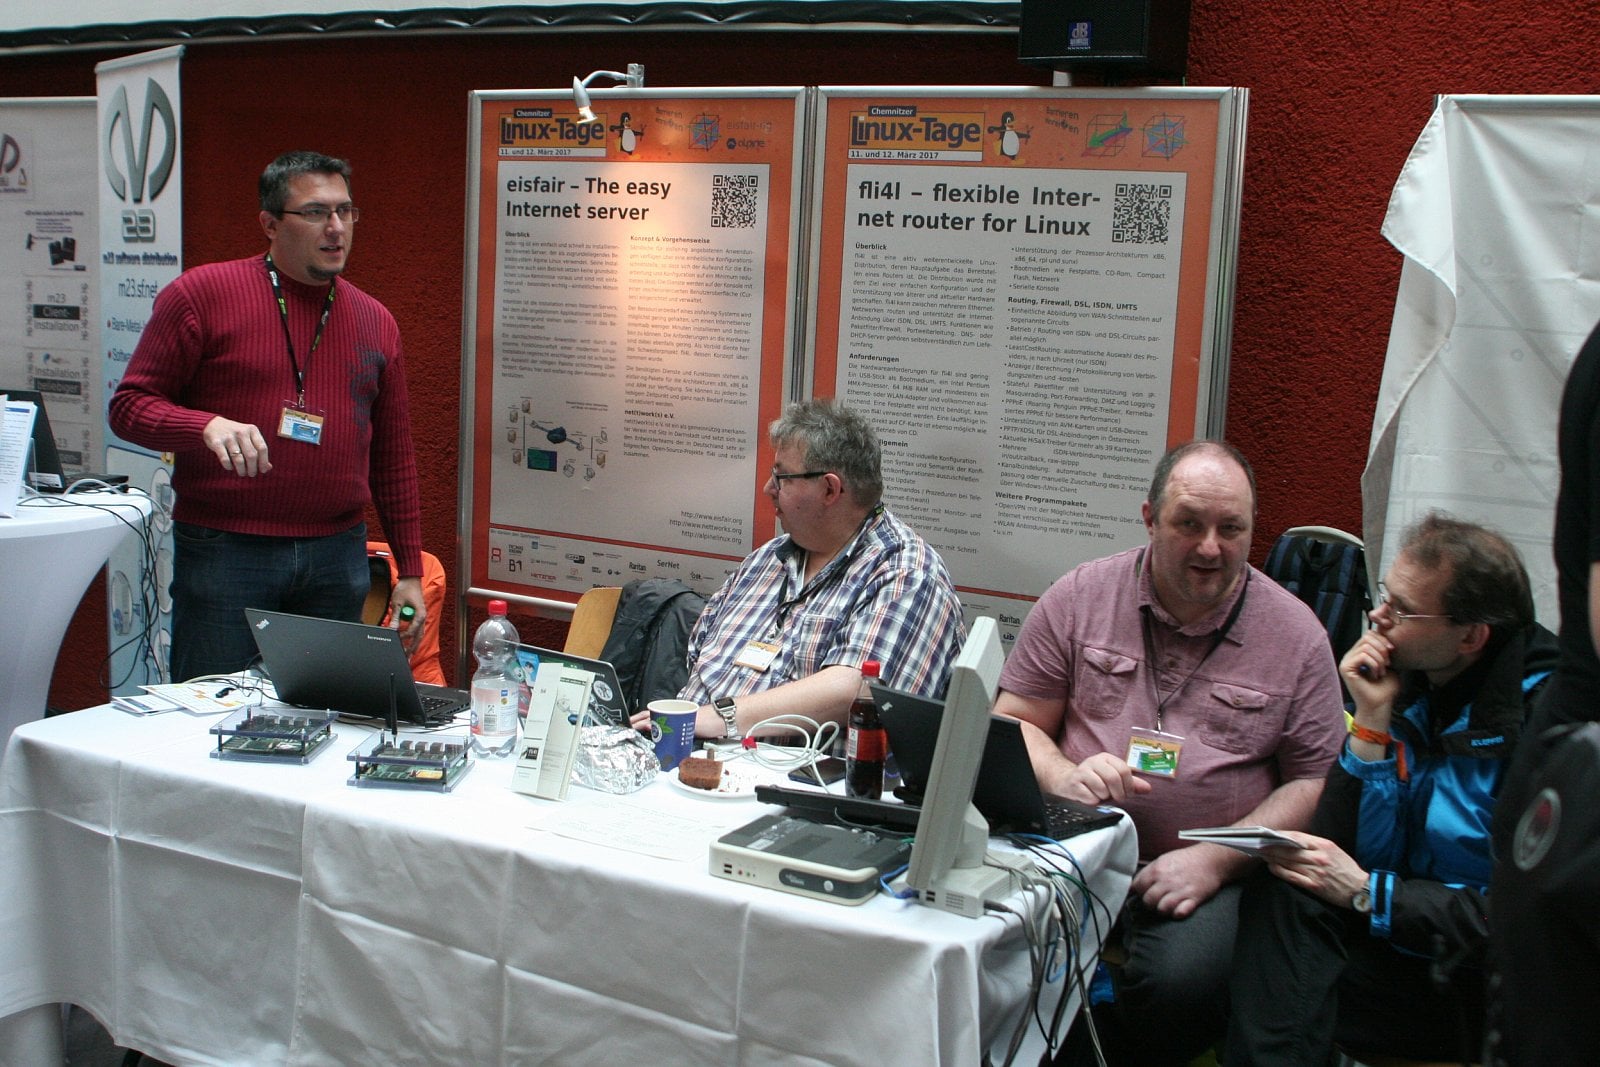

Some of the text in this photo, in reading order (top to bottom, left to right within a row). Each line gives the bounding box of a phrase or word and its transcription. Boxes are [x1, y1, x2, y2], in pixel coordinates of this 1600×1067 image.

[501, 118, 604, 145] Linux-Tage
[852, 116, 980, 148] Linux-Tage
[507, 176, 565, 193] eisfair
[585, 178, 619, 194] The
[626, 182, 671, 199] easy
[859, 181, 900, 200] fli4l
[933, 183, 1020, 204] flexible
[1032, 187, 1100, 207] Inter-
[506, 201, 649, 220] Internet server
[858, 210, 1091, 236] net router for Linux
[855, 241, 887, 249] Überblick
[1015, 246, 1057, 255] Unterstützung
[1008, 296, 1037, 305] Routing,
[1040, 298, 1071, 307] Firewall,
[1074, 300, 1090, 308] DSL,
[1093, 302, 1113, 310] ISDN,
[1047, 309, 1077, 318] Abbildung
[34, 320, 79, 332] Installation
[849, 353, 899, 363] Anforderungen
[34, 367, 80, 378] Installation
[1035, 364, 1070, 373] Berechnung
[1076, 368, 1121, 378] Protokollierung
[995, 491, 1087, 507] Weitere Programmpakete
[1016, 522, 1046, 532] Anbindung
[509, 559, 522, 572] B1
[657, 560, 680, 569] SerNet
